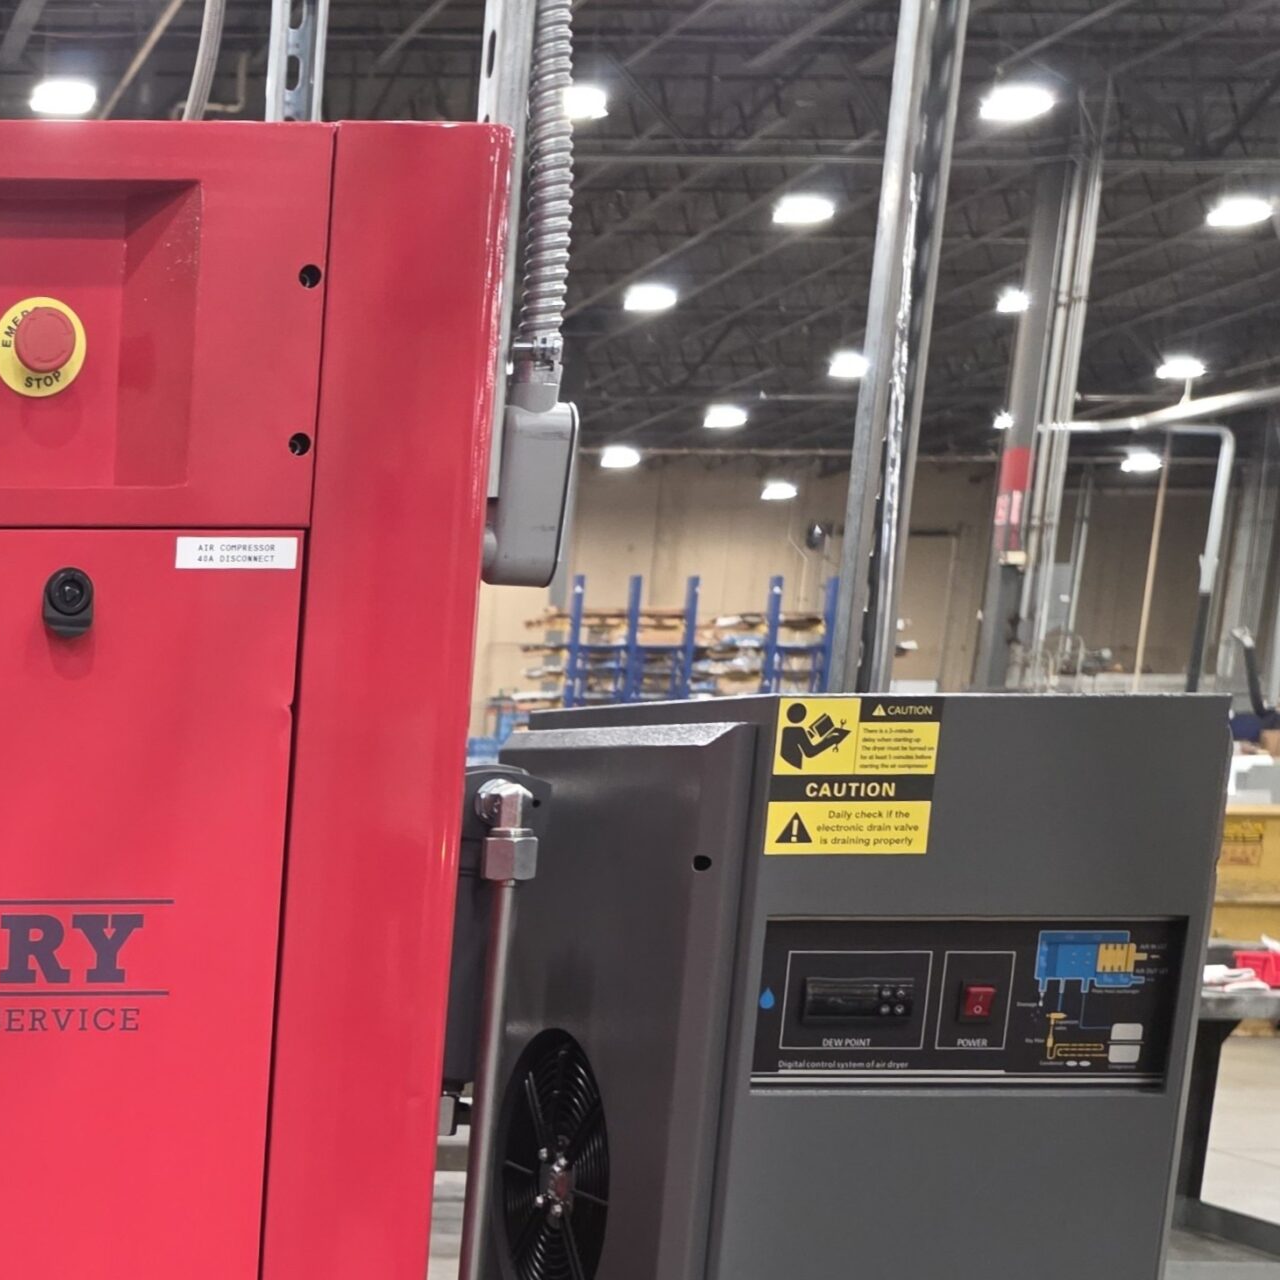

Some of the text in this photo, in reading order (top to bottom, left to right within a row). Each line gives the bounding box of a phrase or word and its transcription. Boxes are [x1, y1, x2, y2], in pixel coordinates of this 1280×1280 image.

[24, 370, 61, 389] STOP
[197, 544, 276, 552] AIR COMPRESSOR
[887, 705, 933, 716] CAUTION
[805, 782, 896, 797] CAUTION
[828, 810, 910, 820] Daily check if the
[816, 824, 919, 832] electronic drain valve
[820, 836, 913, 847] is draining properly
[822, 1038, 871, 1047] DEW POINT
[957, 1038, 988, 1047] POWER
[778, 1060, 909, 1069] Digital control system of air dryer
